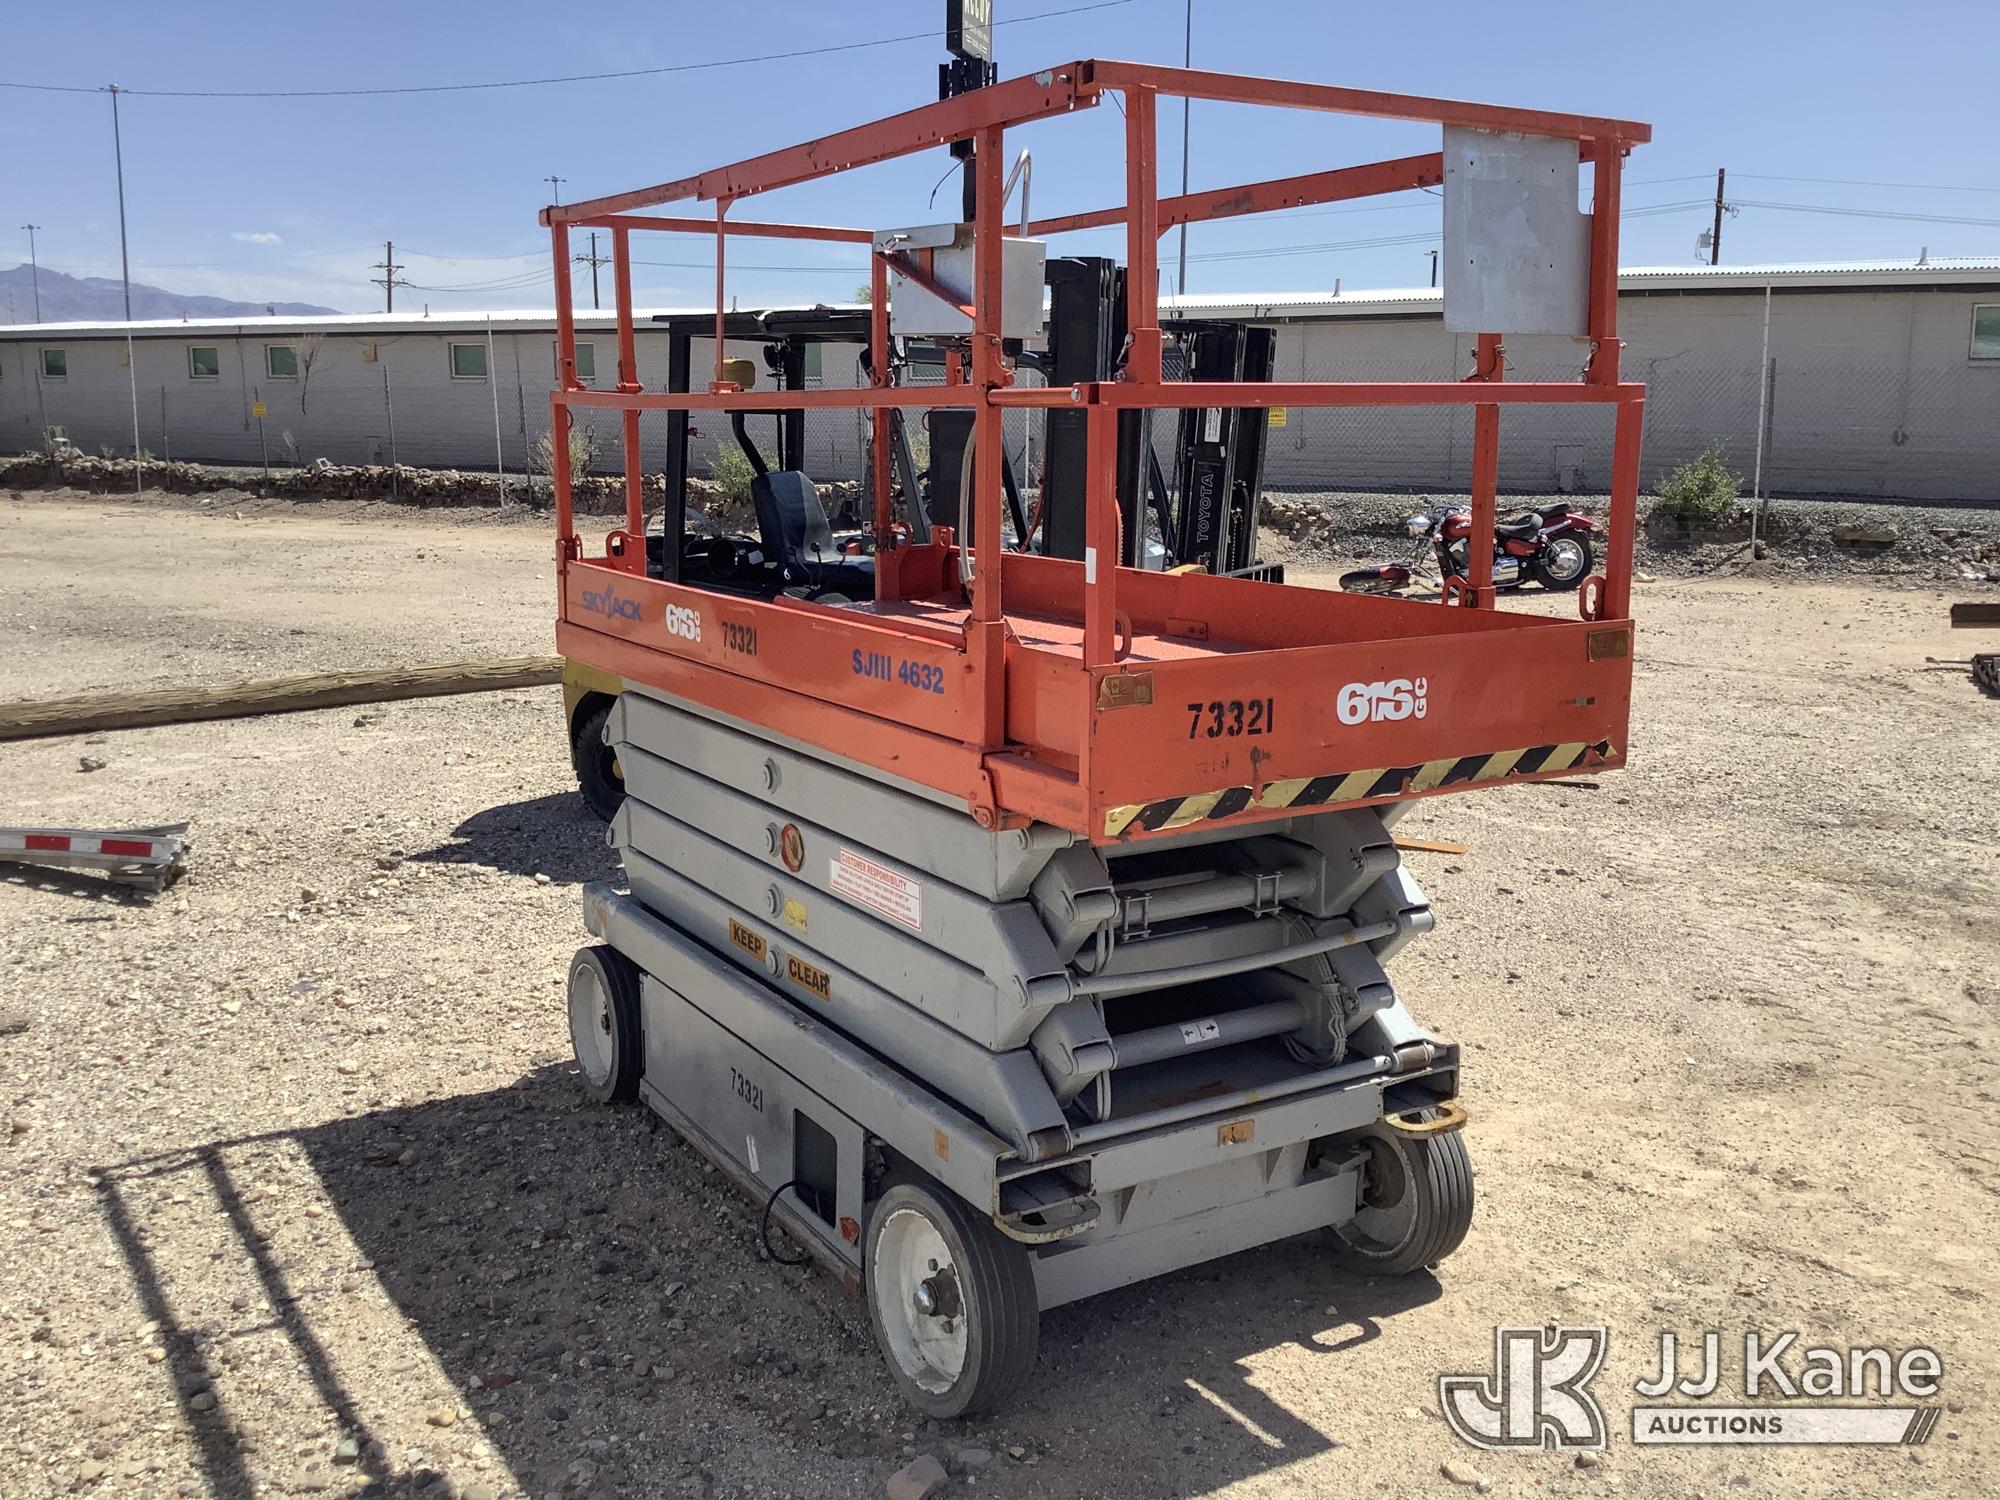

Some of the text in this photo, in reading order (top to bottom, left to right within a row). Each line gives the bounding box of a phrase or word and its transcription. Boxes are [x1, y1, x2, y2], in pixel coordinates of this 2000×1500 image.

[1197, 473, 1215, 543] TOYOTA
[720, 621, 757, 656] 73321
[852, 648, 945, 694] SJIII 4632
[1187, 697, 1274, 740] 73321
[841, 852, 867, 871] CUSTOMER
[732, 922, 831, 997] KEEP CLEAR
[730, 1066, 764, 1114] 73321
